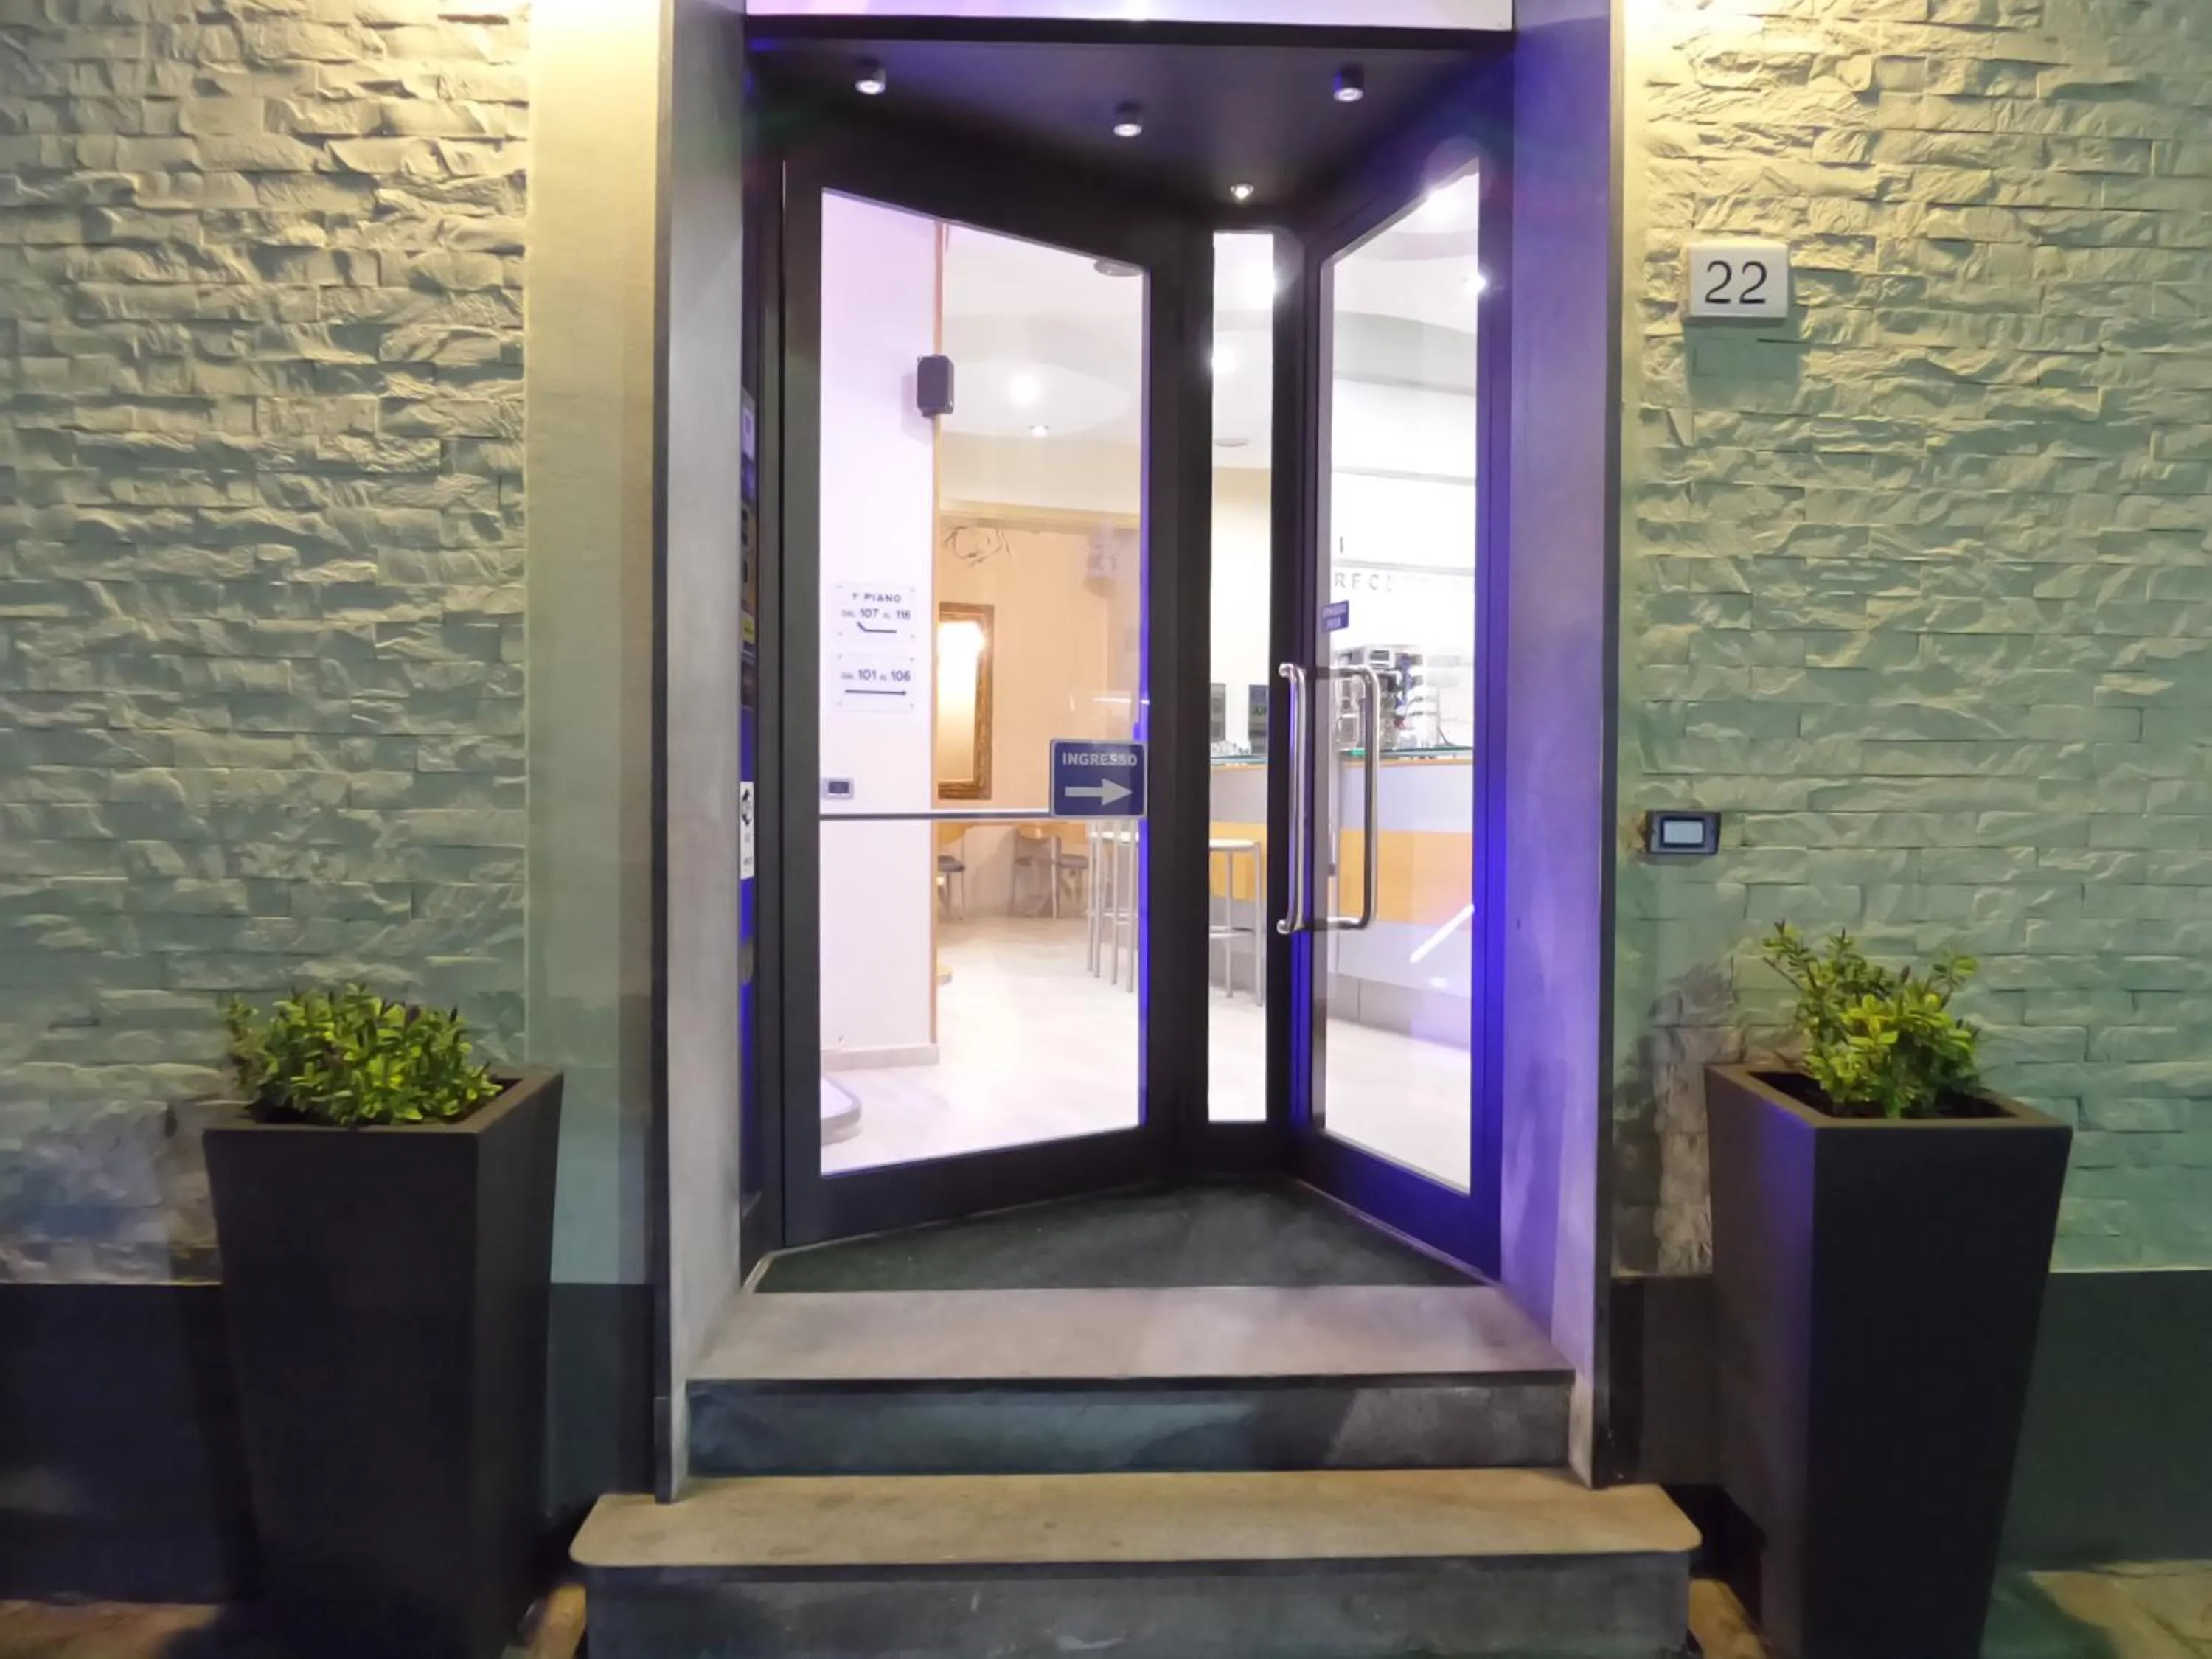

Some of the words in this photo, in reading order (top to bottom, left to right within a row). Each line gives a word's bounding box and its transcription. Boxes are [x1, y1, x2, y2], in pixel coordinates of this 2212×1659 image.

[1704, 260, 1767, 304] 22
[863, 593, 902, 603] PIANO
[860, 608, 879, 619] 107
[858, 669, 877, 681] 101
[891, 669, 911, 681] 106
[1062, 751, 1138, 767] INGRESSO
